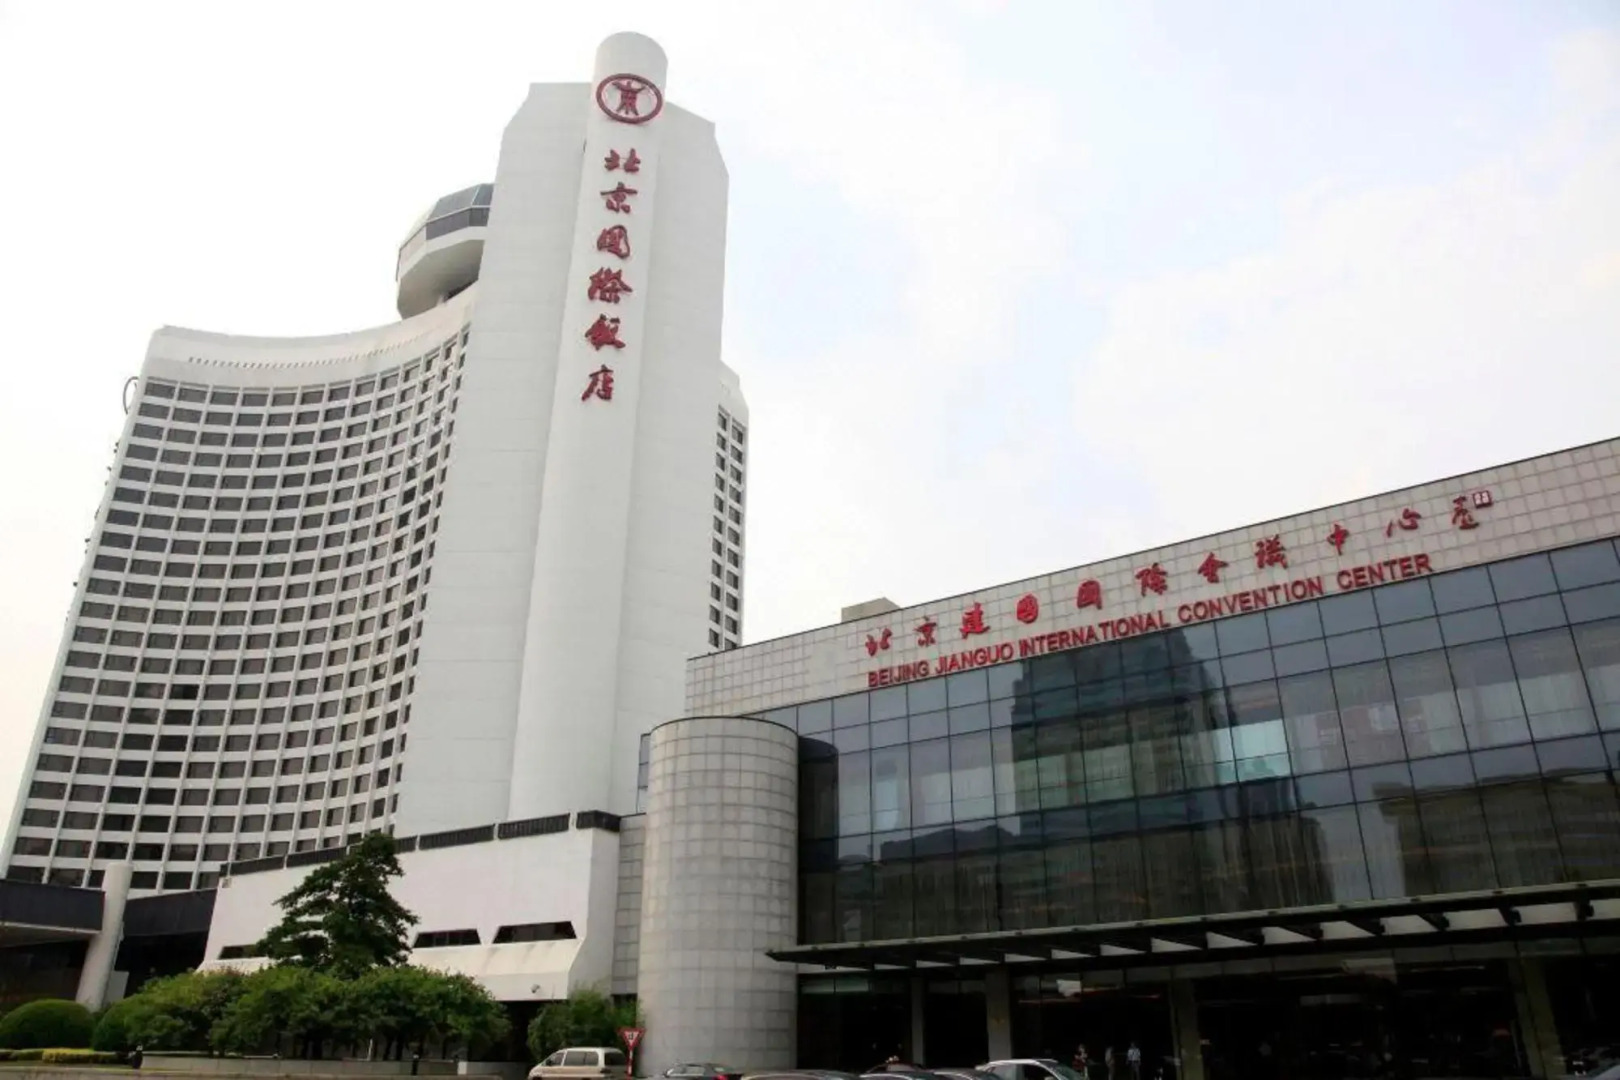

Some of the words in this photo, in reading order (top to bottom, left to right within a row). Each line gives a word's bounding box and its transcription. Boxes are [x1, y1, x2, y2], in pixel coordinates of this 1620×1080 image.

[868, 660, 930, 687] BEIJING
[935, 643, 1015, 674] JIANGUO
[1018, 610, 1171, 658] INTERNATIONAL
[1178, 576, 1324, 624] CONVENTION
[1337, 553, 1434, 591] CENTER
